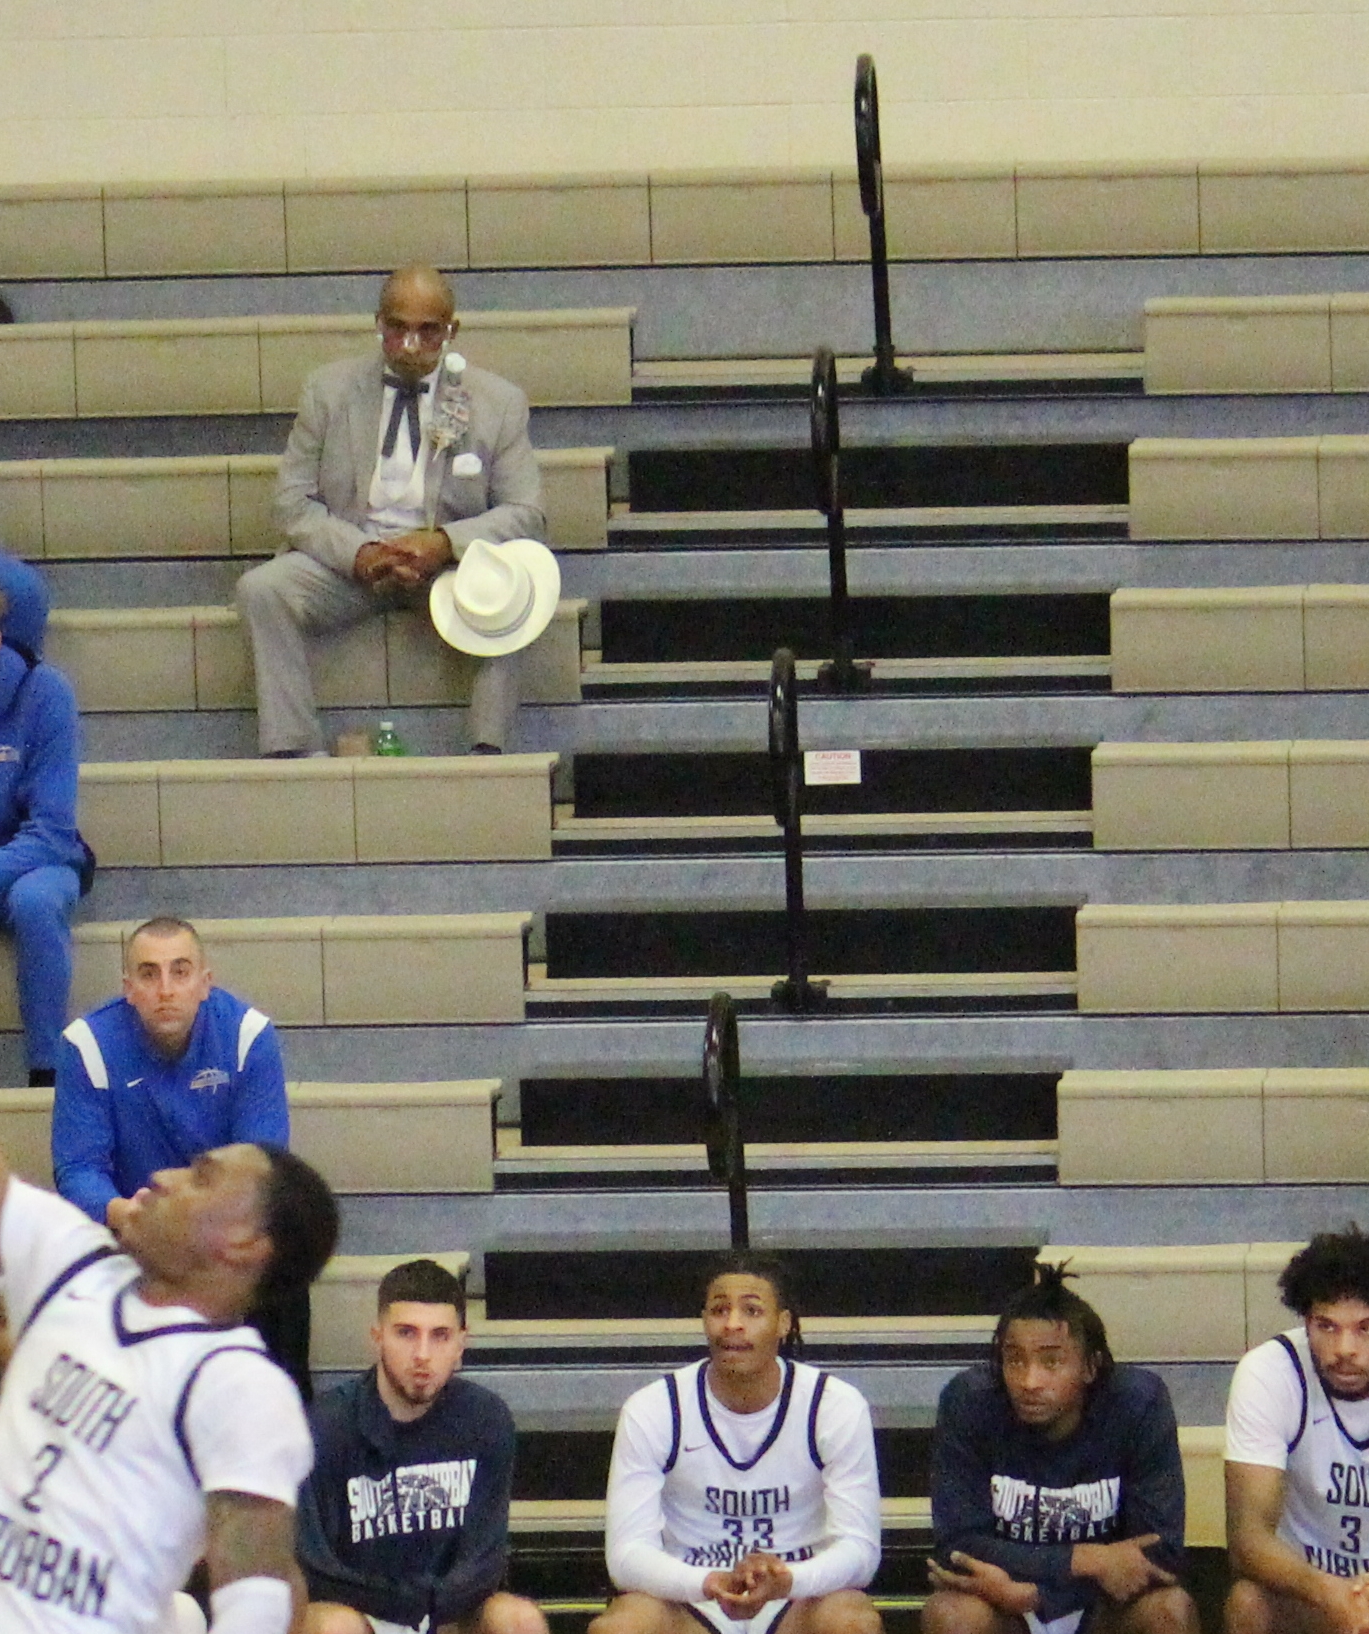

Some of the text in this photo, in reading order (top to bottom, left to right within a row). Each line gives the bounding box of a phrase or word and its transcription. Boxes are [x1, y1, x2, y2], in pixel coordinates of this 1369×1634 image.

[28, 1352, 139, 1454] SOUTH
[21, 1443, 63, 1514] 2
[704, 1485, 790, 1517] SOUTH
[722, 1518, 774, 1550] 33
[1340, 1515, 1361, 1554] 3
